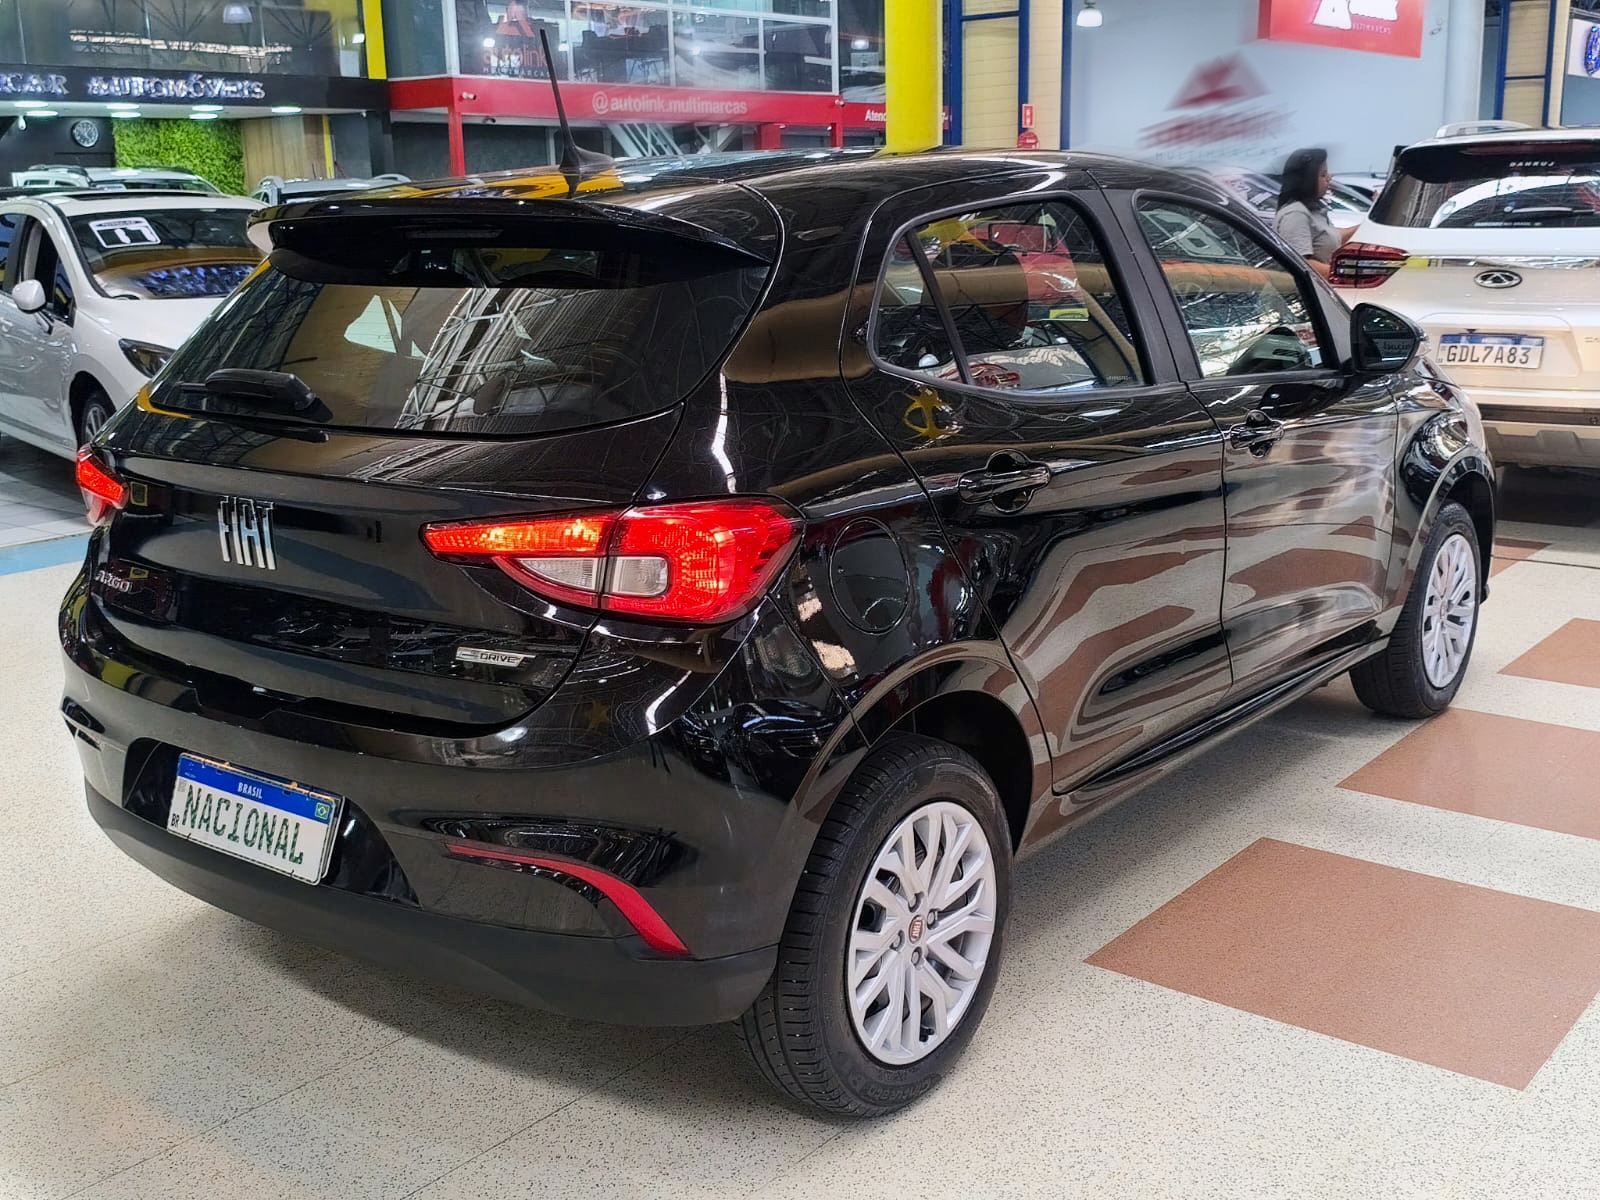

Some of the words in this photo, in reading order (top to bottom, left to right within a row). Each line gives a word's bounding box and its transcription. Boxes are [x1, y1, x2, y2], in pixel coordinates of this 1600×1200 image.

[1446, 345, 1531, 365] GDL7A83
[217, 495, 277, 571] FIAT
[237, 781, 263, 800] BRASIL
[171, 813, 180, 829] BR
[181, 783, 304, 865] NACIONAL
